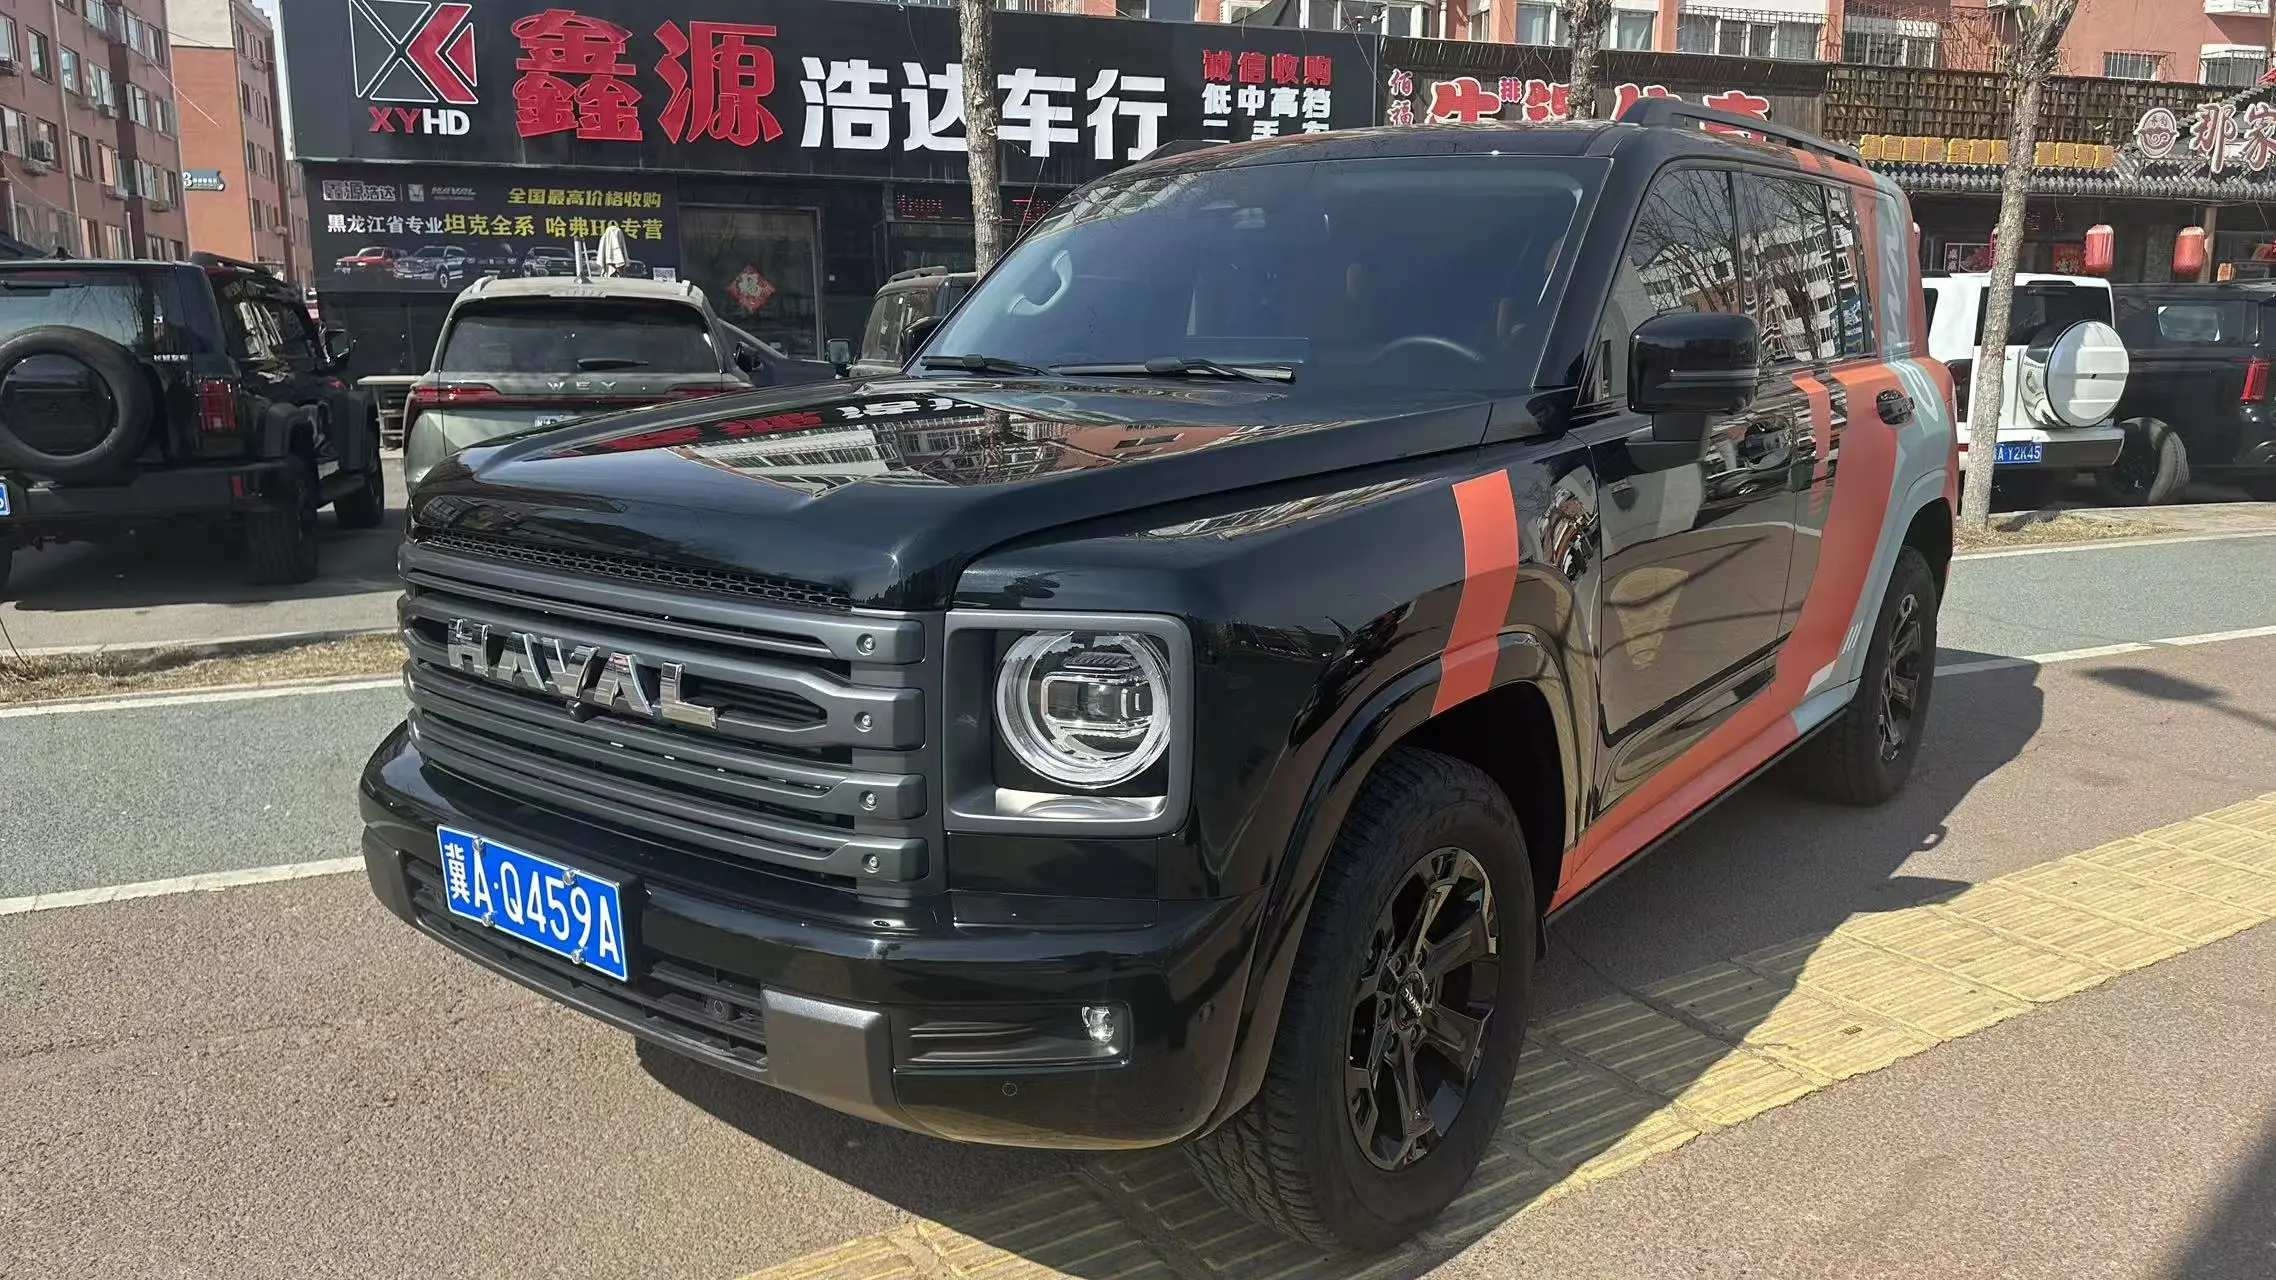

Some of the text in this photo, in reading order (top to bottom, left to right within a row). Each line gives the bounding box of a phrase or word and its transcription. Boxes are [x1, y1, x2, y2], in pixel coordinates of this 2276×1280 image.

[1203, 49, 1332, 86] 诚信收购
[1201, 83, 1331, 119] 低中高档
[368, 106, 471, 137] XYHD
[507, 187, 662, 209] 全国最高价格收购
[327, 213, 535, 238] 黑龙江省专业坦克全系
[547, 380, 617, 392] WEY
[448, 617, 719, 730] HAVAL
